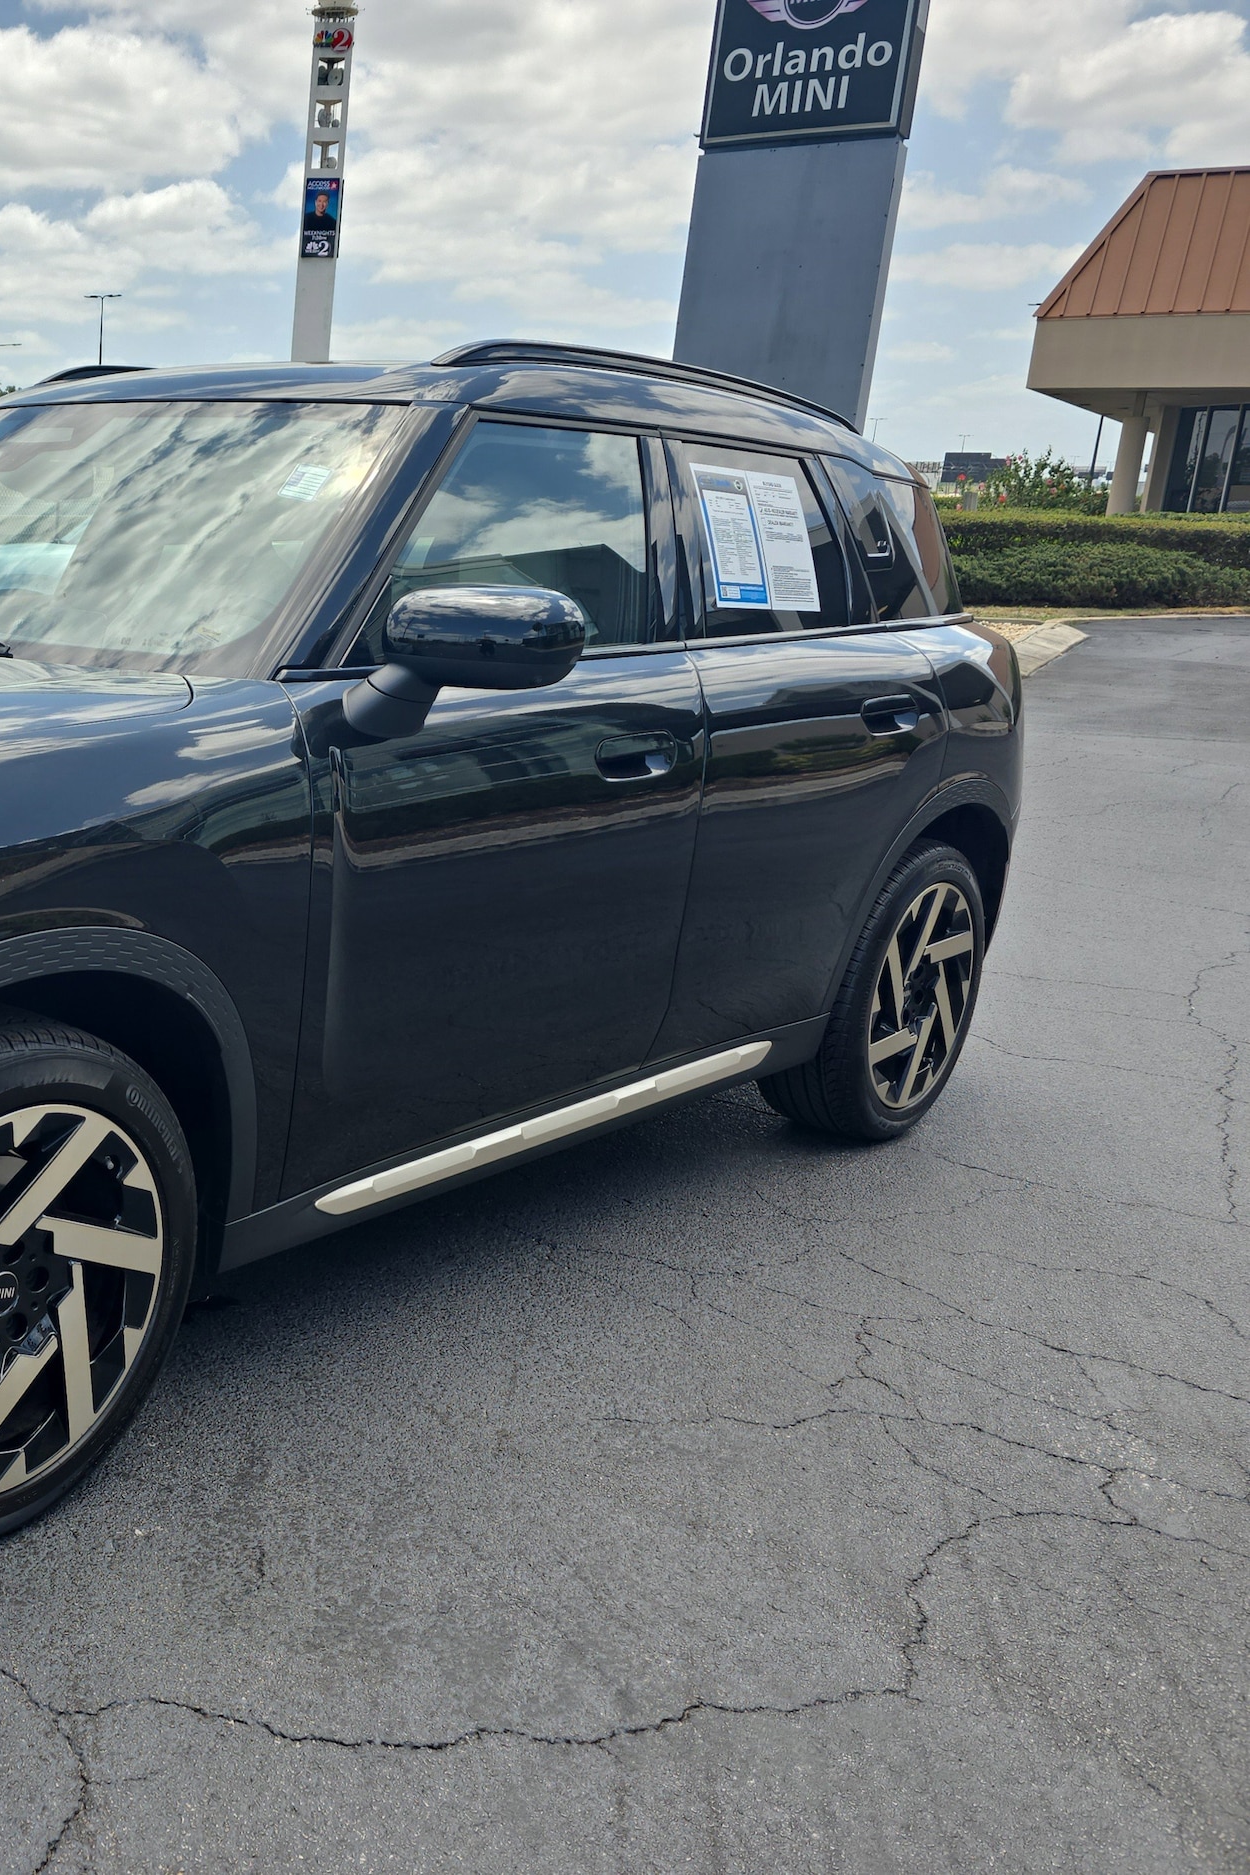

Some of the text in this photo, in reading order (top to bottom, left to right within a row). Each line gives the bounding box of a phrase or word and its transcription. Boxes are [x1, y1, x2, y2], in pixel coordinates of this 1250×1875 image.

[333, 28, 350, 51] 2
[723, 32, 893, 82] Orlando
[751, 75, 850, 118] MINI
[318, 240, 329, 256] 2
[125, 1084, 180, 1162] Continental
